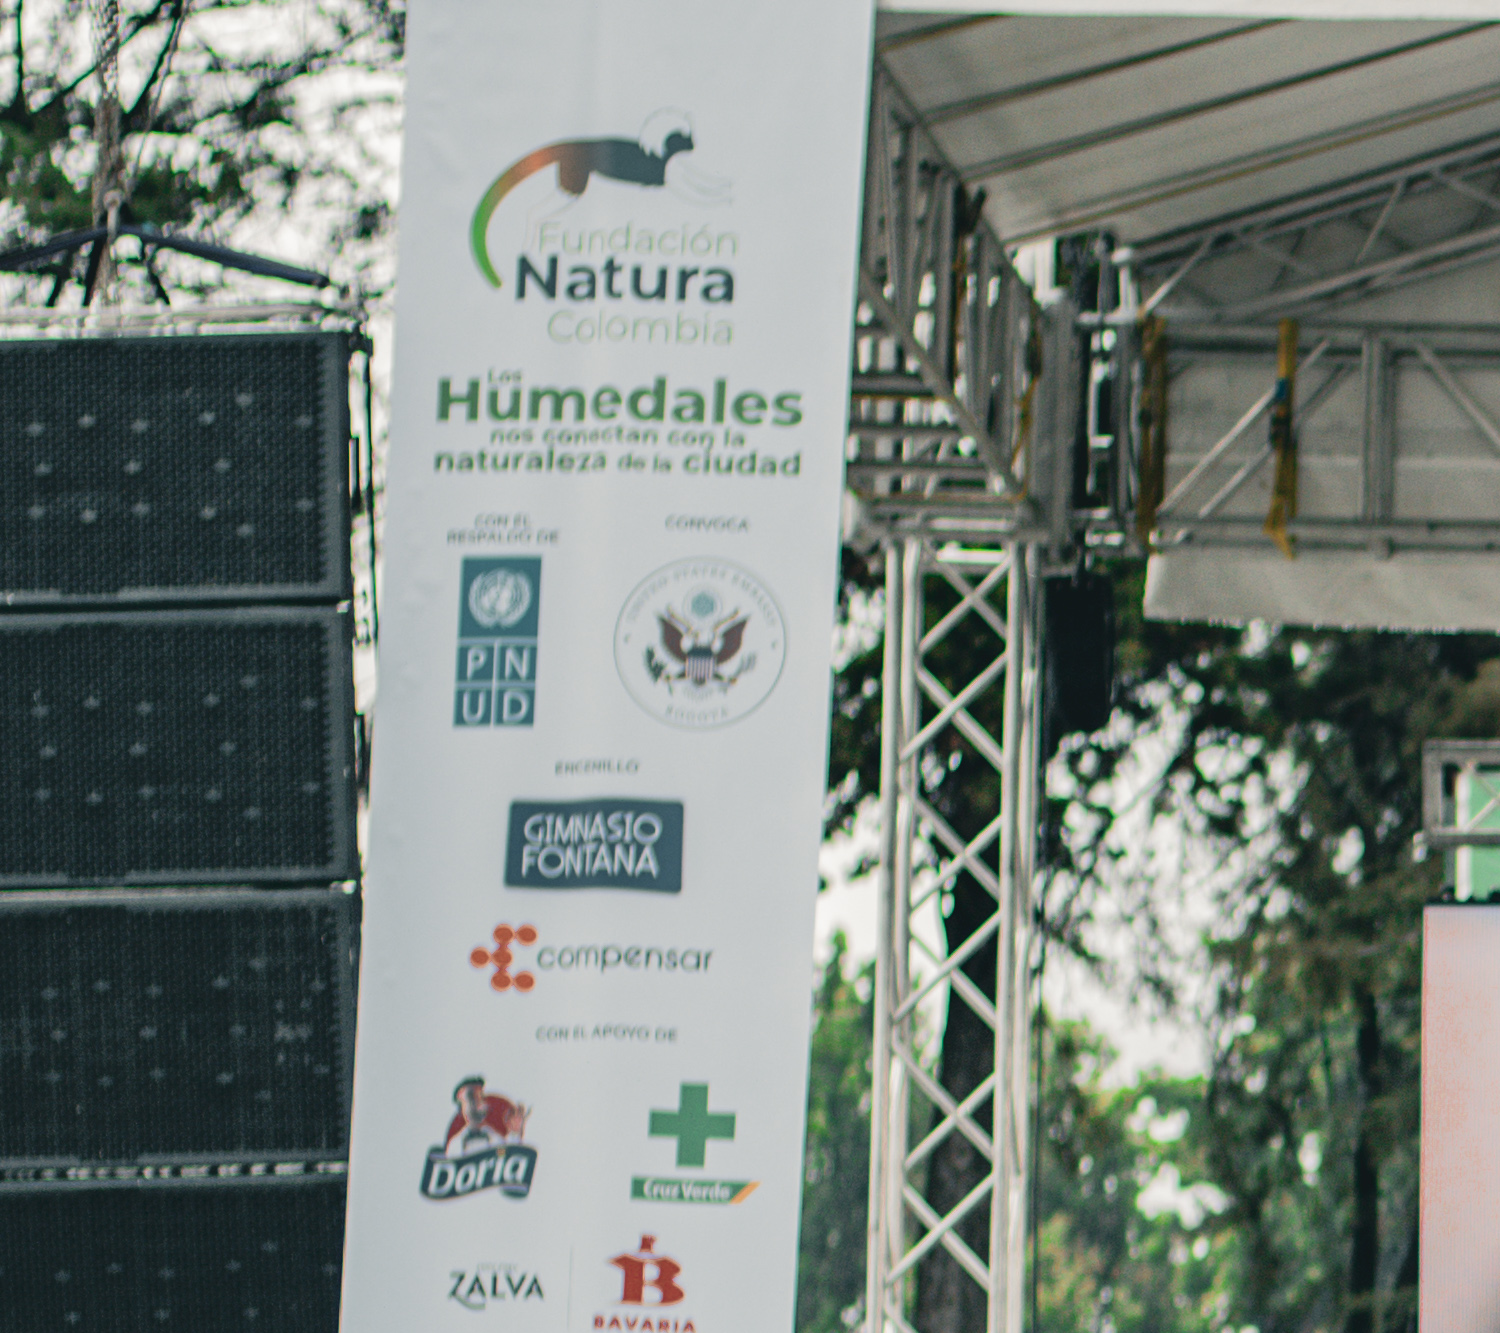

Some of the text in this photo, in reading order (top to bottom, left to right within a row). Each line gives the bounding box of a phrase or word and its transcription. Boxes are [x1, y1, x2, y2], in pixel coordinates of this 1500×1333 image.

[537, 222, 738, 257] Fundación
[515, 254, 735, 304] Natura
[547, 310, 734, 346] Colombia
[490, 424, 746, 448] nos conectan con la
[434, 448, 802, 476] naturaleza de la ciudad
[475, 513, 508, 528] CON
[665, 514, 748, 532] CONVOCA
[523, 813, 662, 846] GIMNASIO
[521, 845, 660, 878] FONTANA
[536, 944, 714, 974] compensar
[535, 1026, 569, 1042] CON
[591, 1025, 650, 1043] APOYO
[655, 1026, 678, 1042] DE
[429, 1153, 528, 1199] Doria
[642, 1179, 731, 1200] Cruz Verde
[448, 1270, 545, 1311] ZALVA
